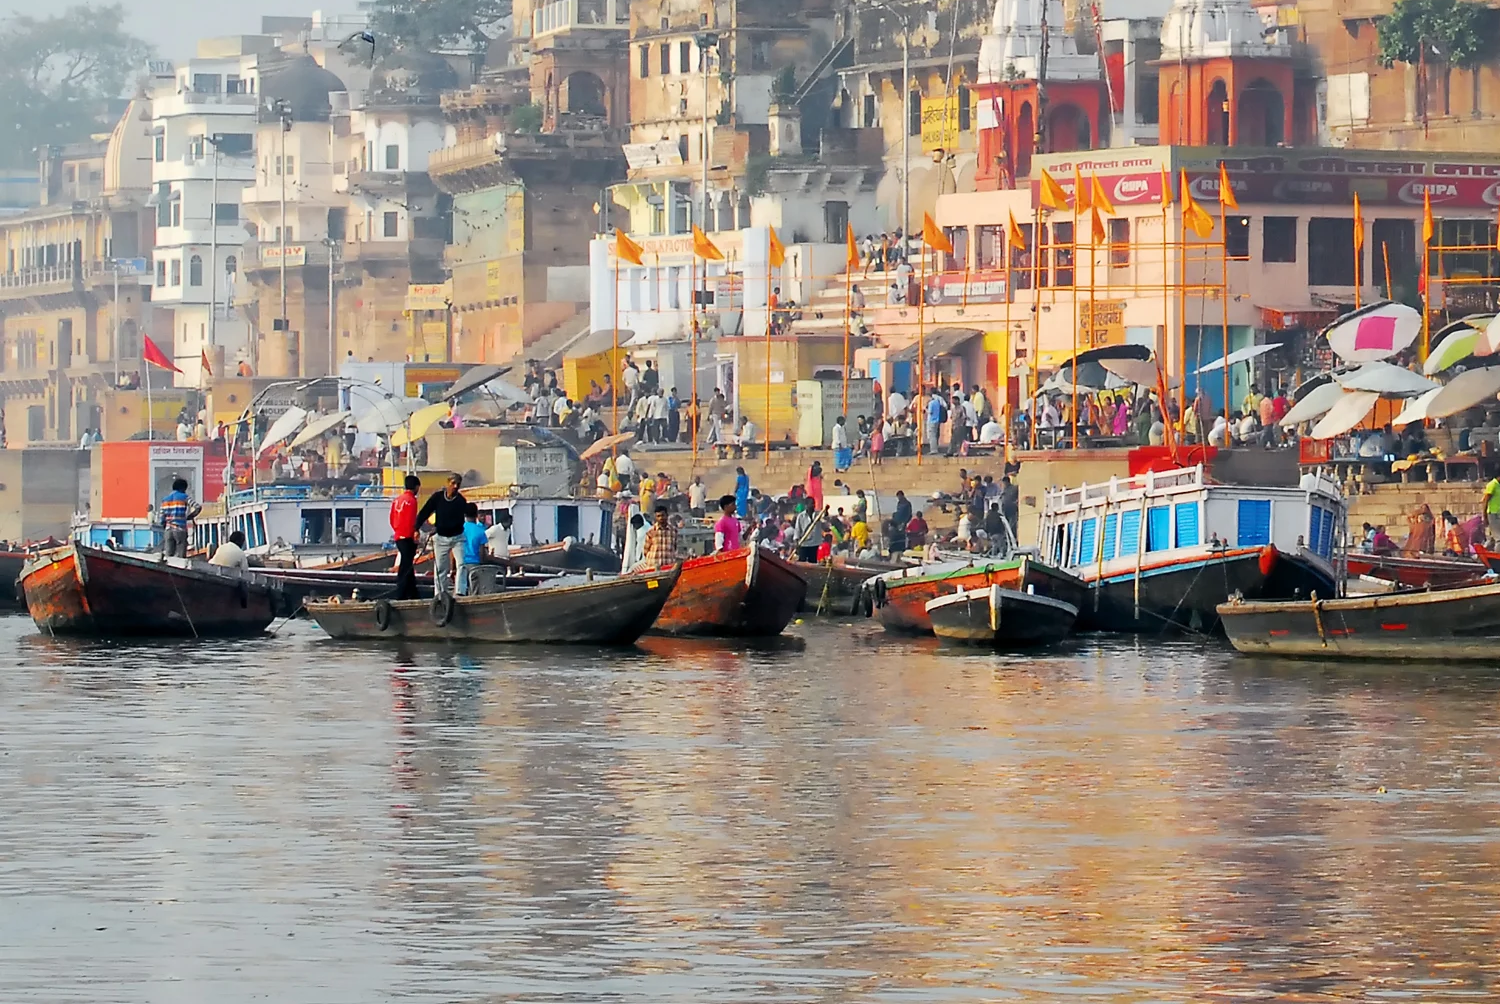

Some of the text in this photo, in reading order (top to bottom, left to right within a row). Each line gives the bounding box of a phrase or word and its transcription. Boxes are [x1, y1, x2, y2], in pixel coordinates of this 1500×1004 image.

[148, 61, 174, 73] SITA
[1121, 180, 1149, 193] RUPA
[1412, 183, 1458, 196] RUPA
